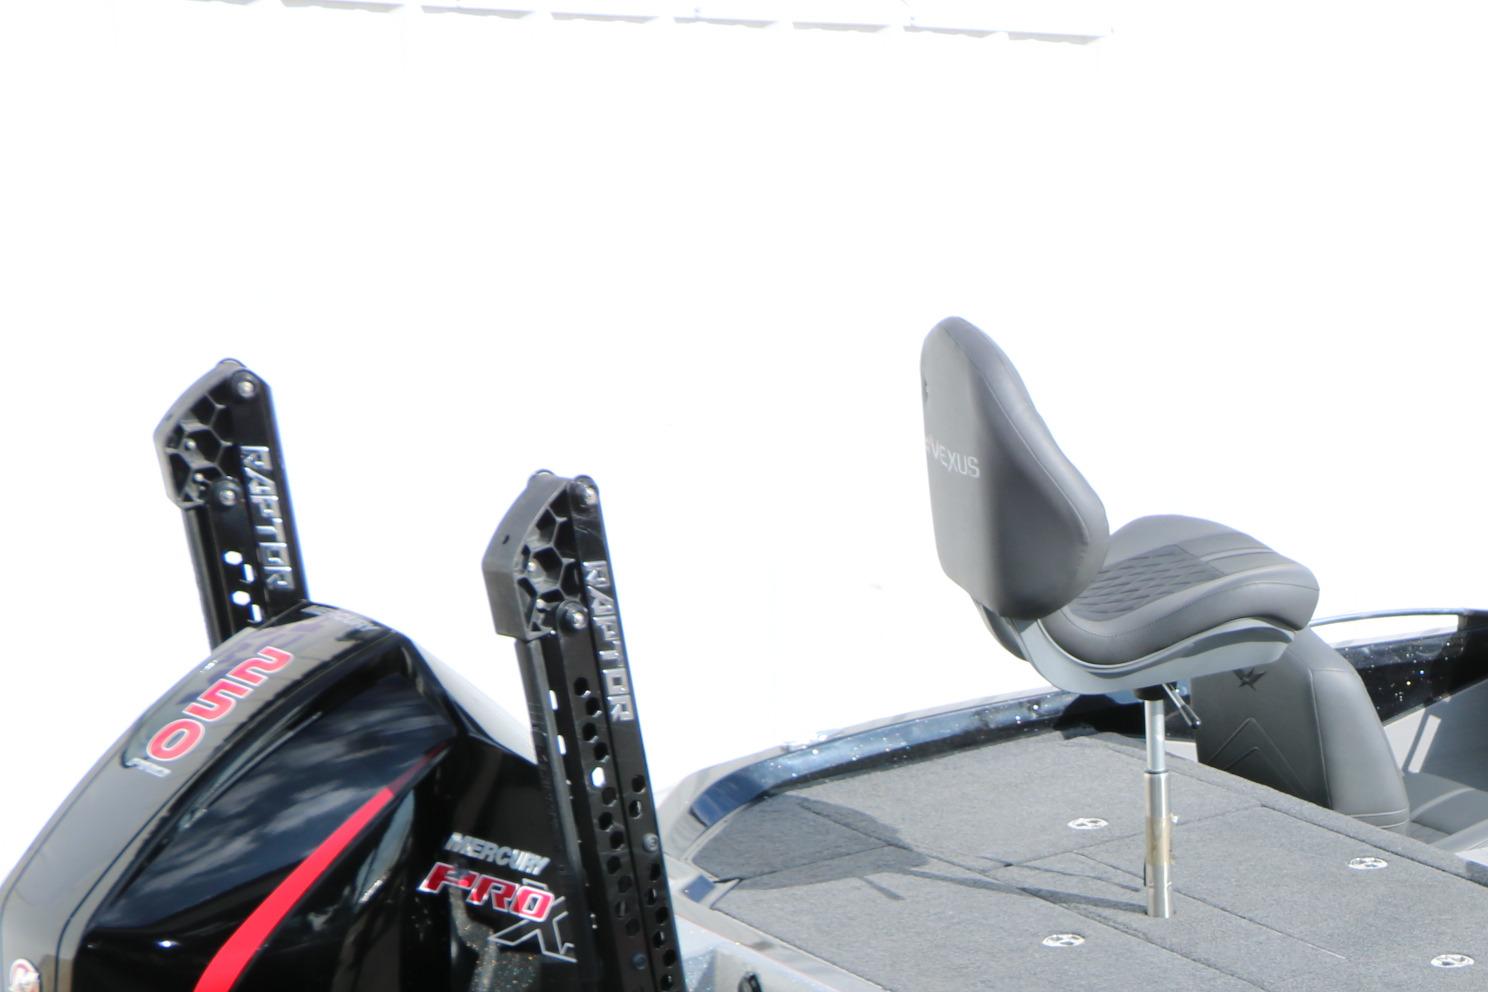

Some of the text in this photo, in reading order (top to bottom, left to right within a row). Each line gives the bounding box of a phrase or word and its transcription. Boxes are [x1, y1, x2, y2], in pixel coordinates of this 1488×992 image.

[930, 439, 980, 478] VEXUS
[240, 445, 295, 590] RAPTOR
[582, 560, 634, 722] RAPTOR
[146, 646, 293, 762] 250
[416, 861, 555, 923] PRO
[445, 832, 551, 876] MERCURY
